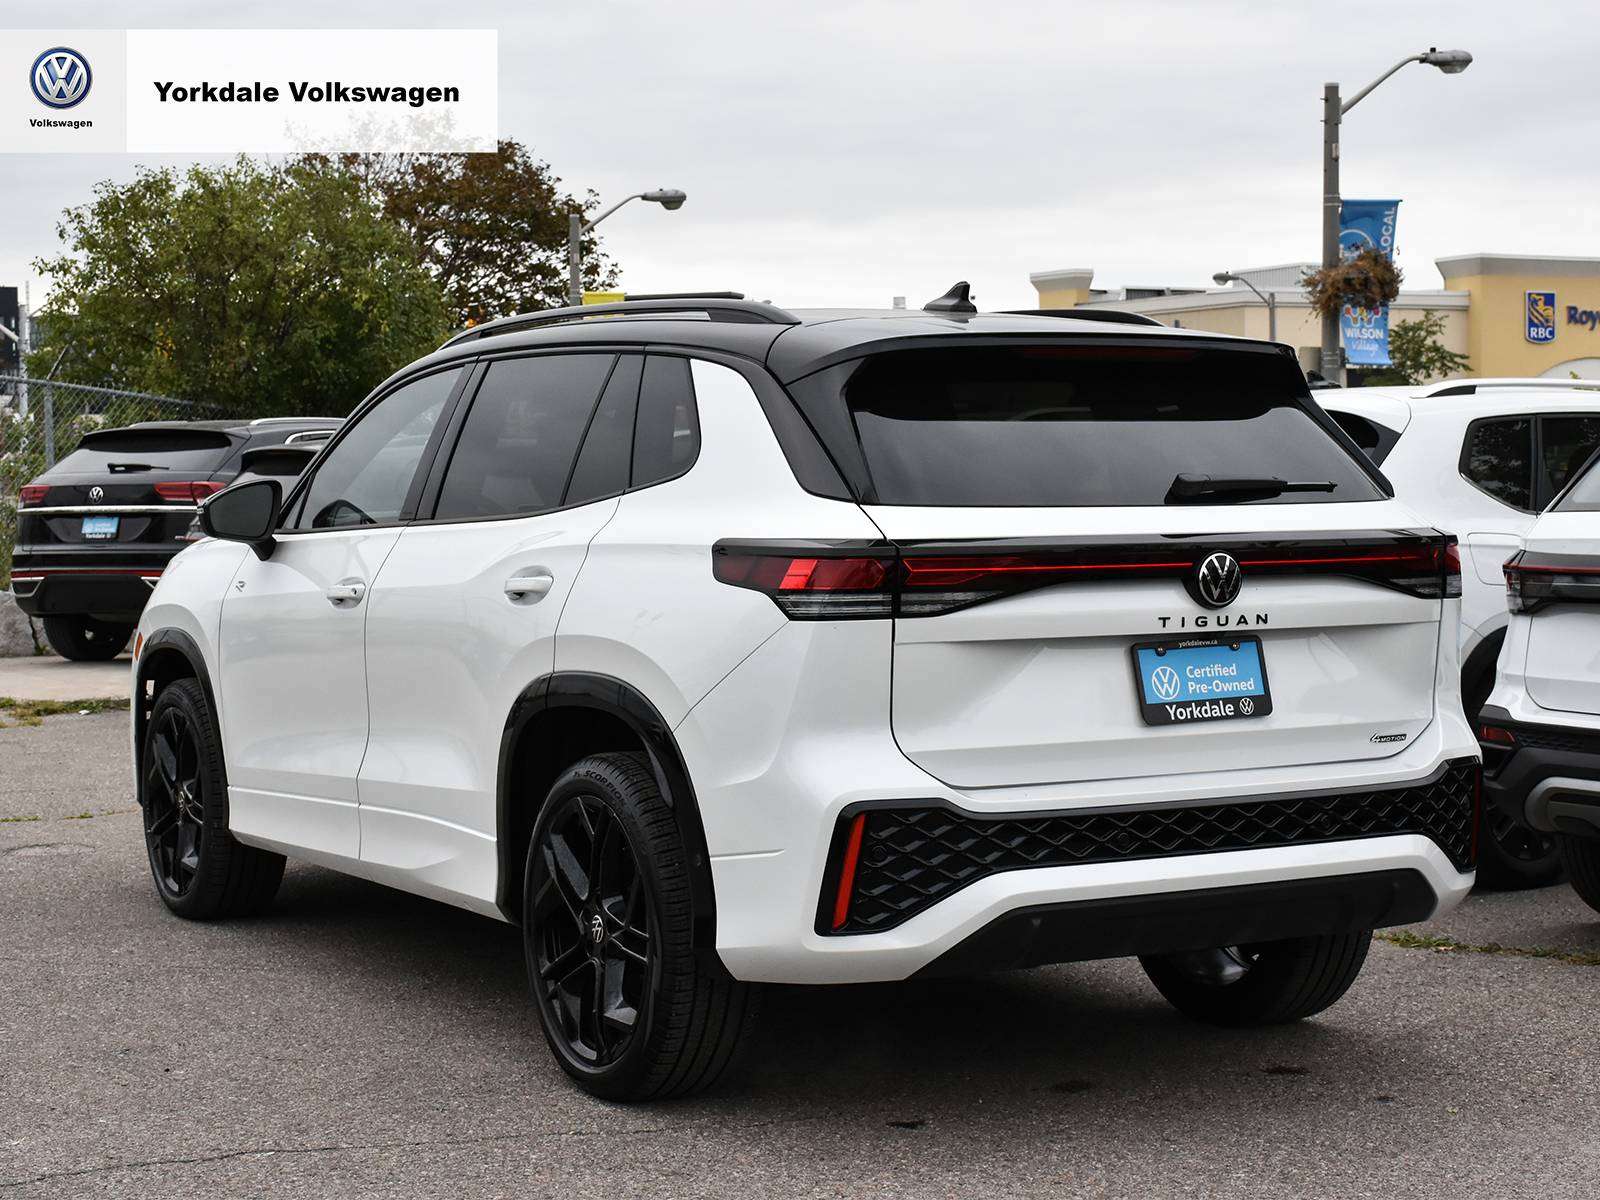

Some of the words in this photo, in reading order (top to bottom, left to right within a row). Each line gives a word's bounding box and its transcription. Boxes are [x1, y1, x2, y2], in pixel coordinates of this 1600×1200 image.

[1566, 305, 1600, 331] Roy
[1345, 328, 1384, 339] WILSON
[1530, 327, 1554, 339] RBC
[1158, 613, 1269, 628] TIGUAN
[1186, 663, 1237, 678] Certified
[1188, 678, 1255, 694] Pre-Owned
[1165, 700, 1234, 720] Yorkdale
